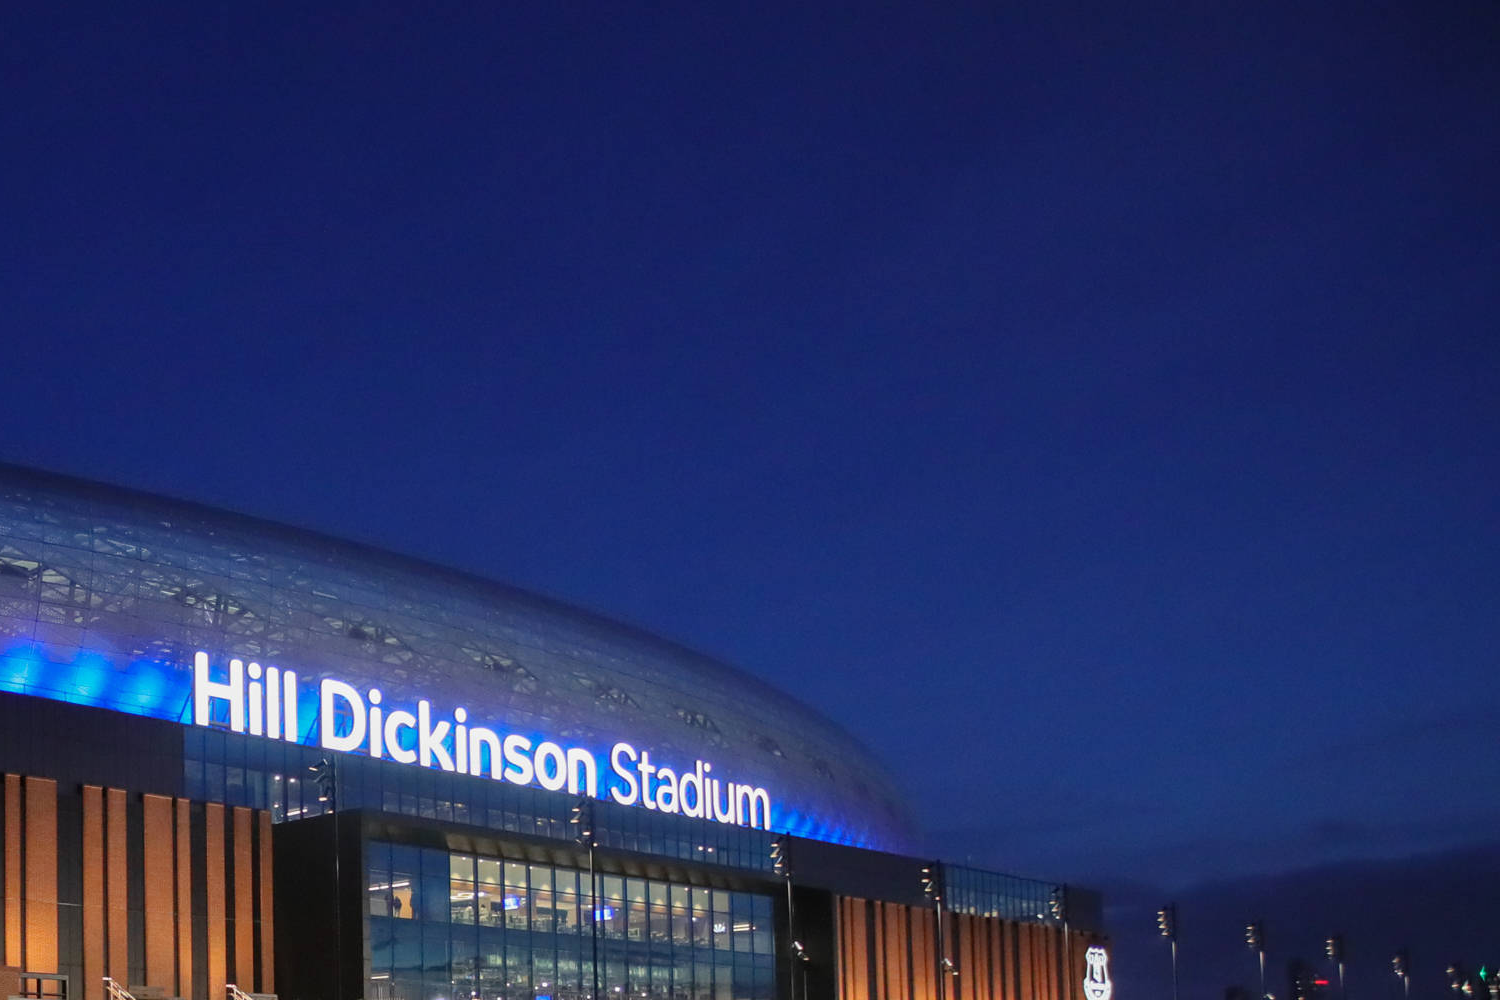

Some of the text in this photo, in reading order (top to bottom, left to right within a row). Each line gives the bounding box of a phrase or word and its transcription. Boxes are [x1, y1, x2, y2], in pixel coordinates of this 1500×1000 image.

[194, 650, 771, 831] Hill Dickinson Stadium
